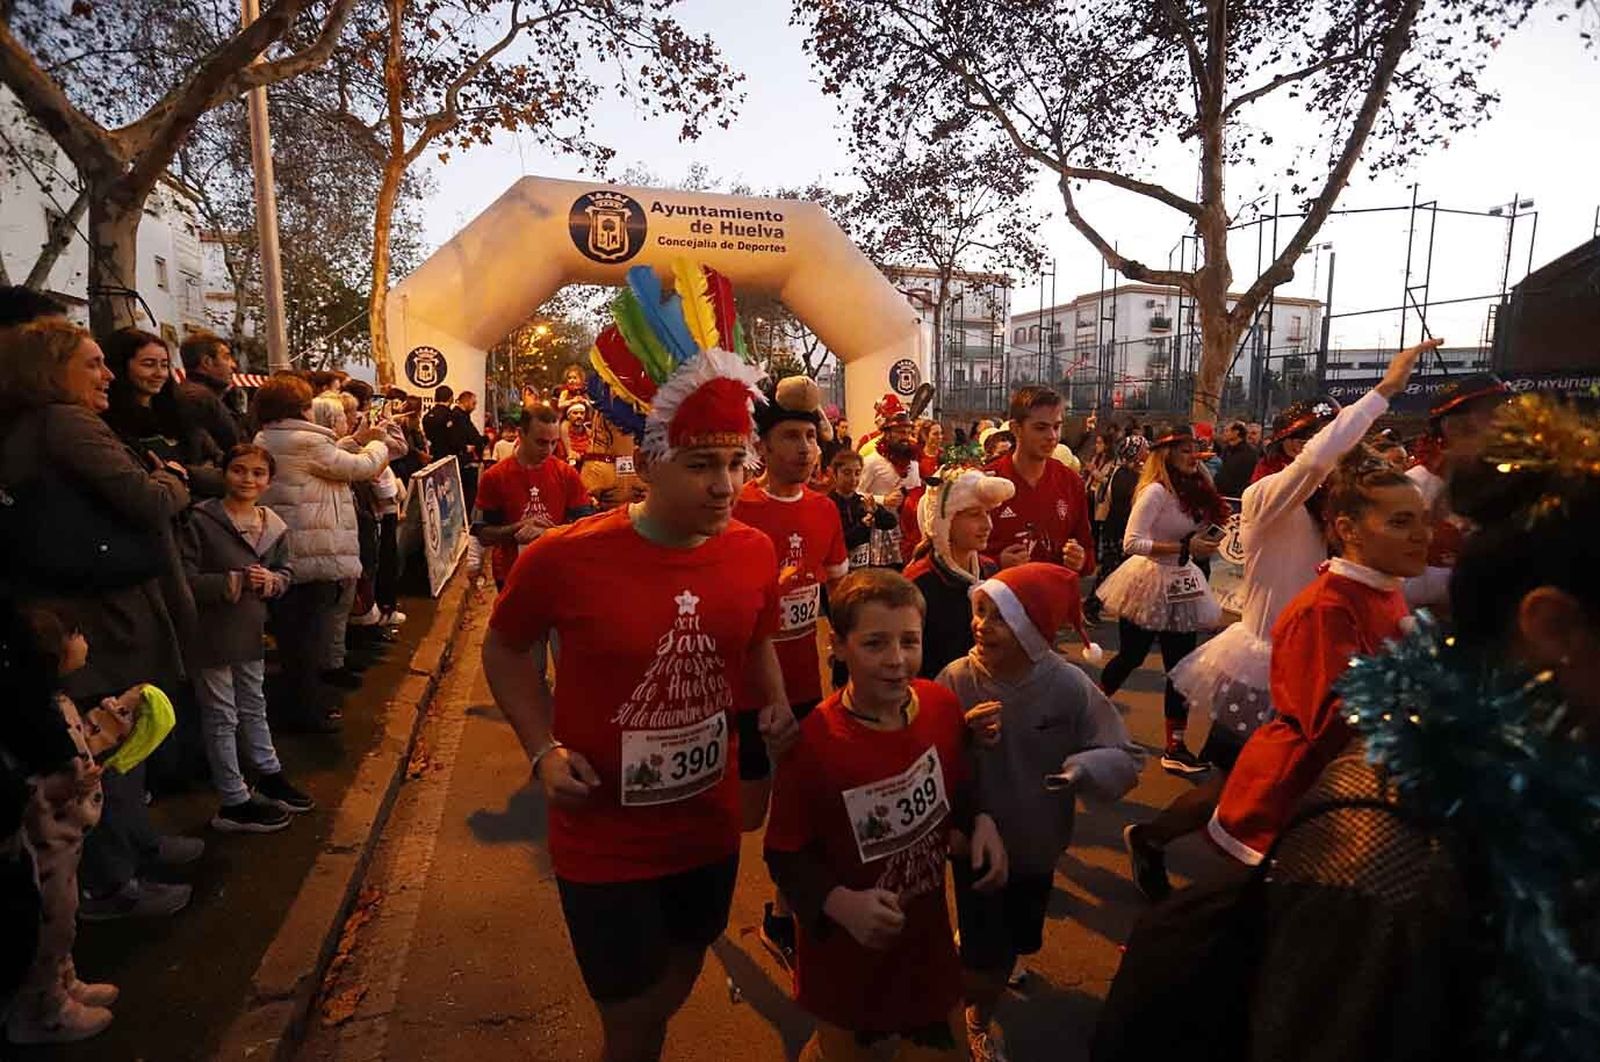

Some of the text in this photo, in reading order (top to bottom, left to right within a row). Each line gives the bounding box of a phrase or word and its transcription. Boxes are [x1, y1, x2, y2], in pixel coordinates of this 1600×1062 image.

[650, 200, 784, 222] Ayuntamiento
[690, 220, 784, 239] de Huelva
[720, 240, 734, 250] de
[737, 241, 786, 253] Deportes
[1537, 377, 1600, 391] HYUNDA
[790, 600, 815, 624] 392
[671, 741, 719, 780] 390
[897, 778, 936, 826] 389
